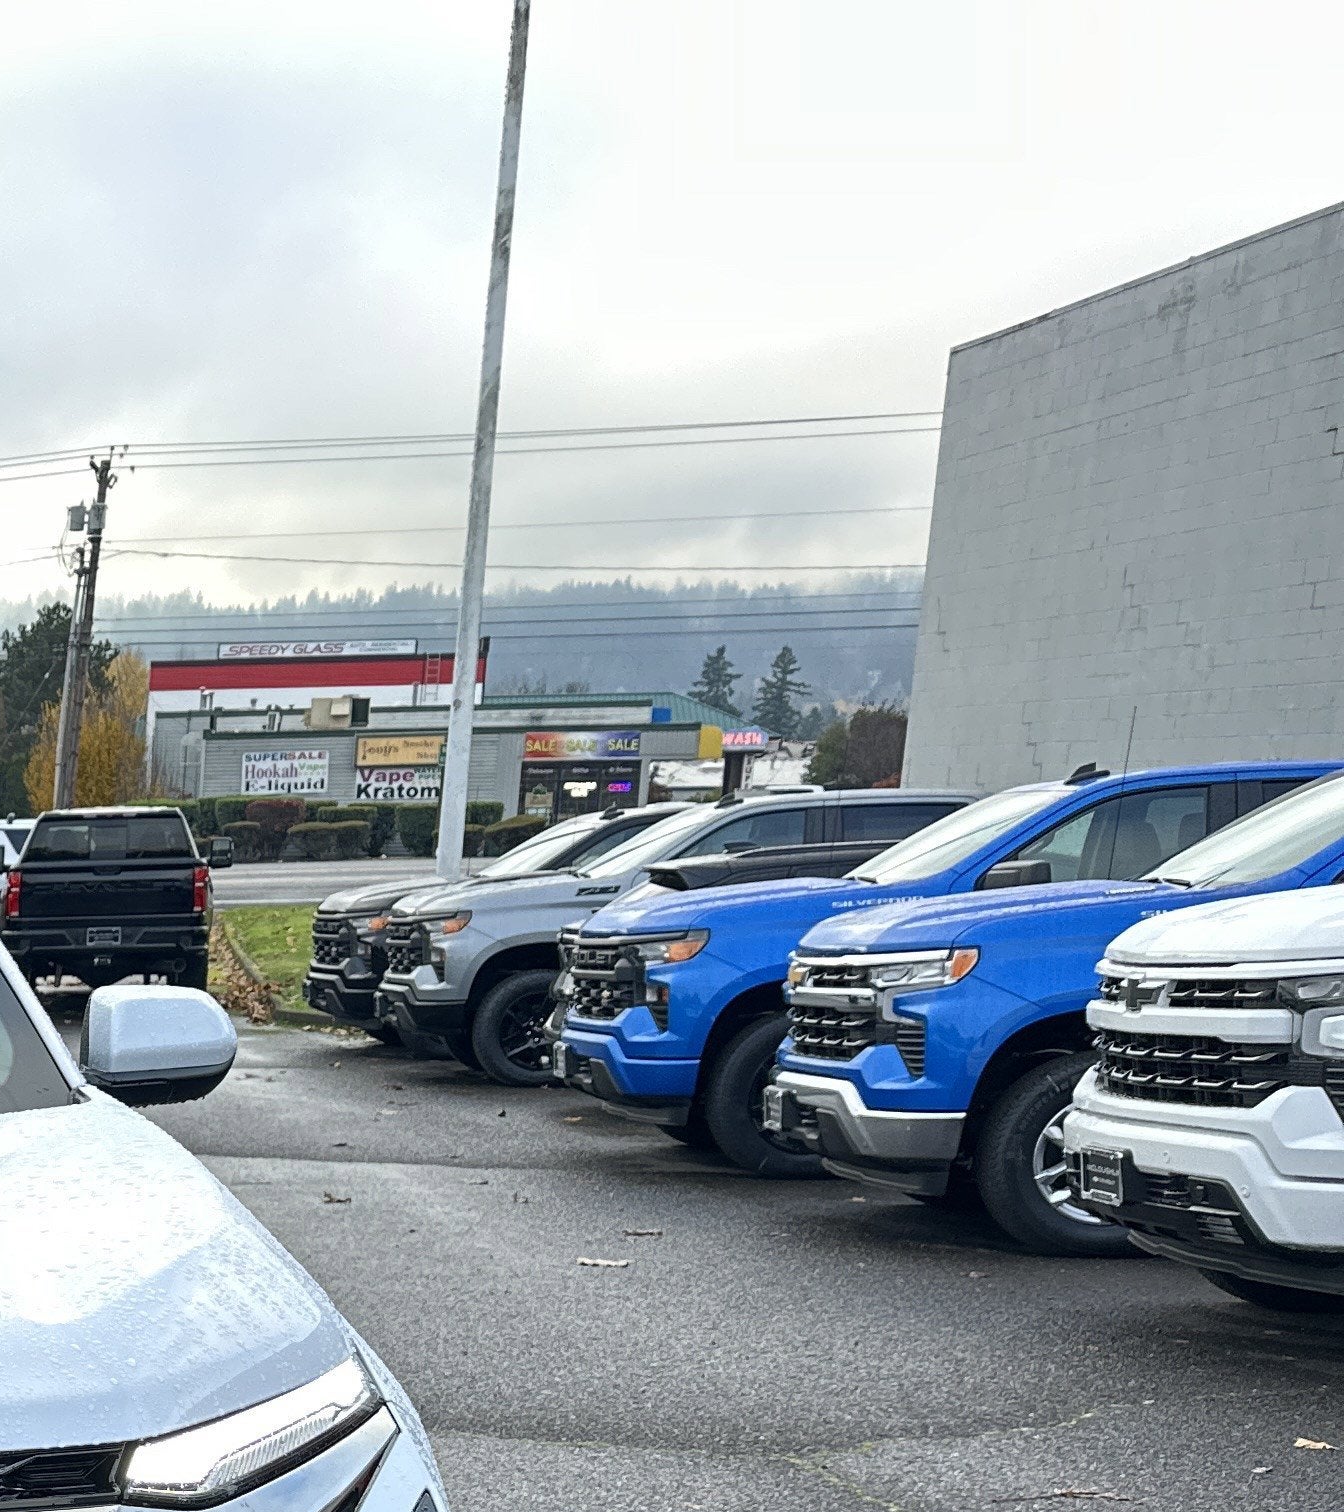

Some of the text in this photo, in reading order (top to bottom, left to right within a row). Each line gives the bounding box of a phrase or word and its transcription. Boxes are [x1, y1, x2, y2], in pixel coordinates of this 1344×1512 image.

[223, 641, 346, 657] SPEEDY GLASS
[525, 739, 558, 752] SALE
[607, 738, 640, 751] SALE
[722, 732, 762, 746] WASH
[245, 762, 298, 779] Hookah
[359, 767, 415, 785] Vape
[245, 777, 325, 793] E-liquid
[356, 783, 441, 799] Kratom
